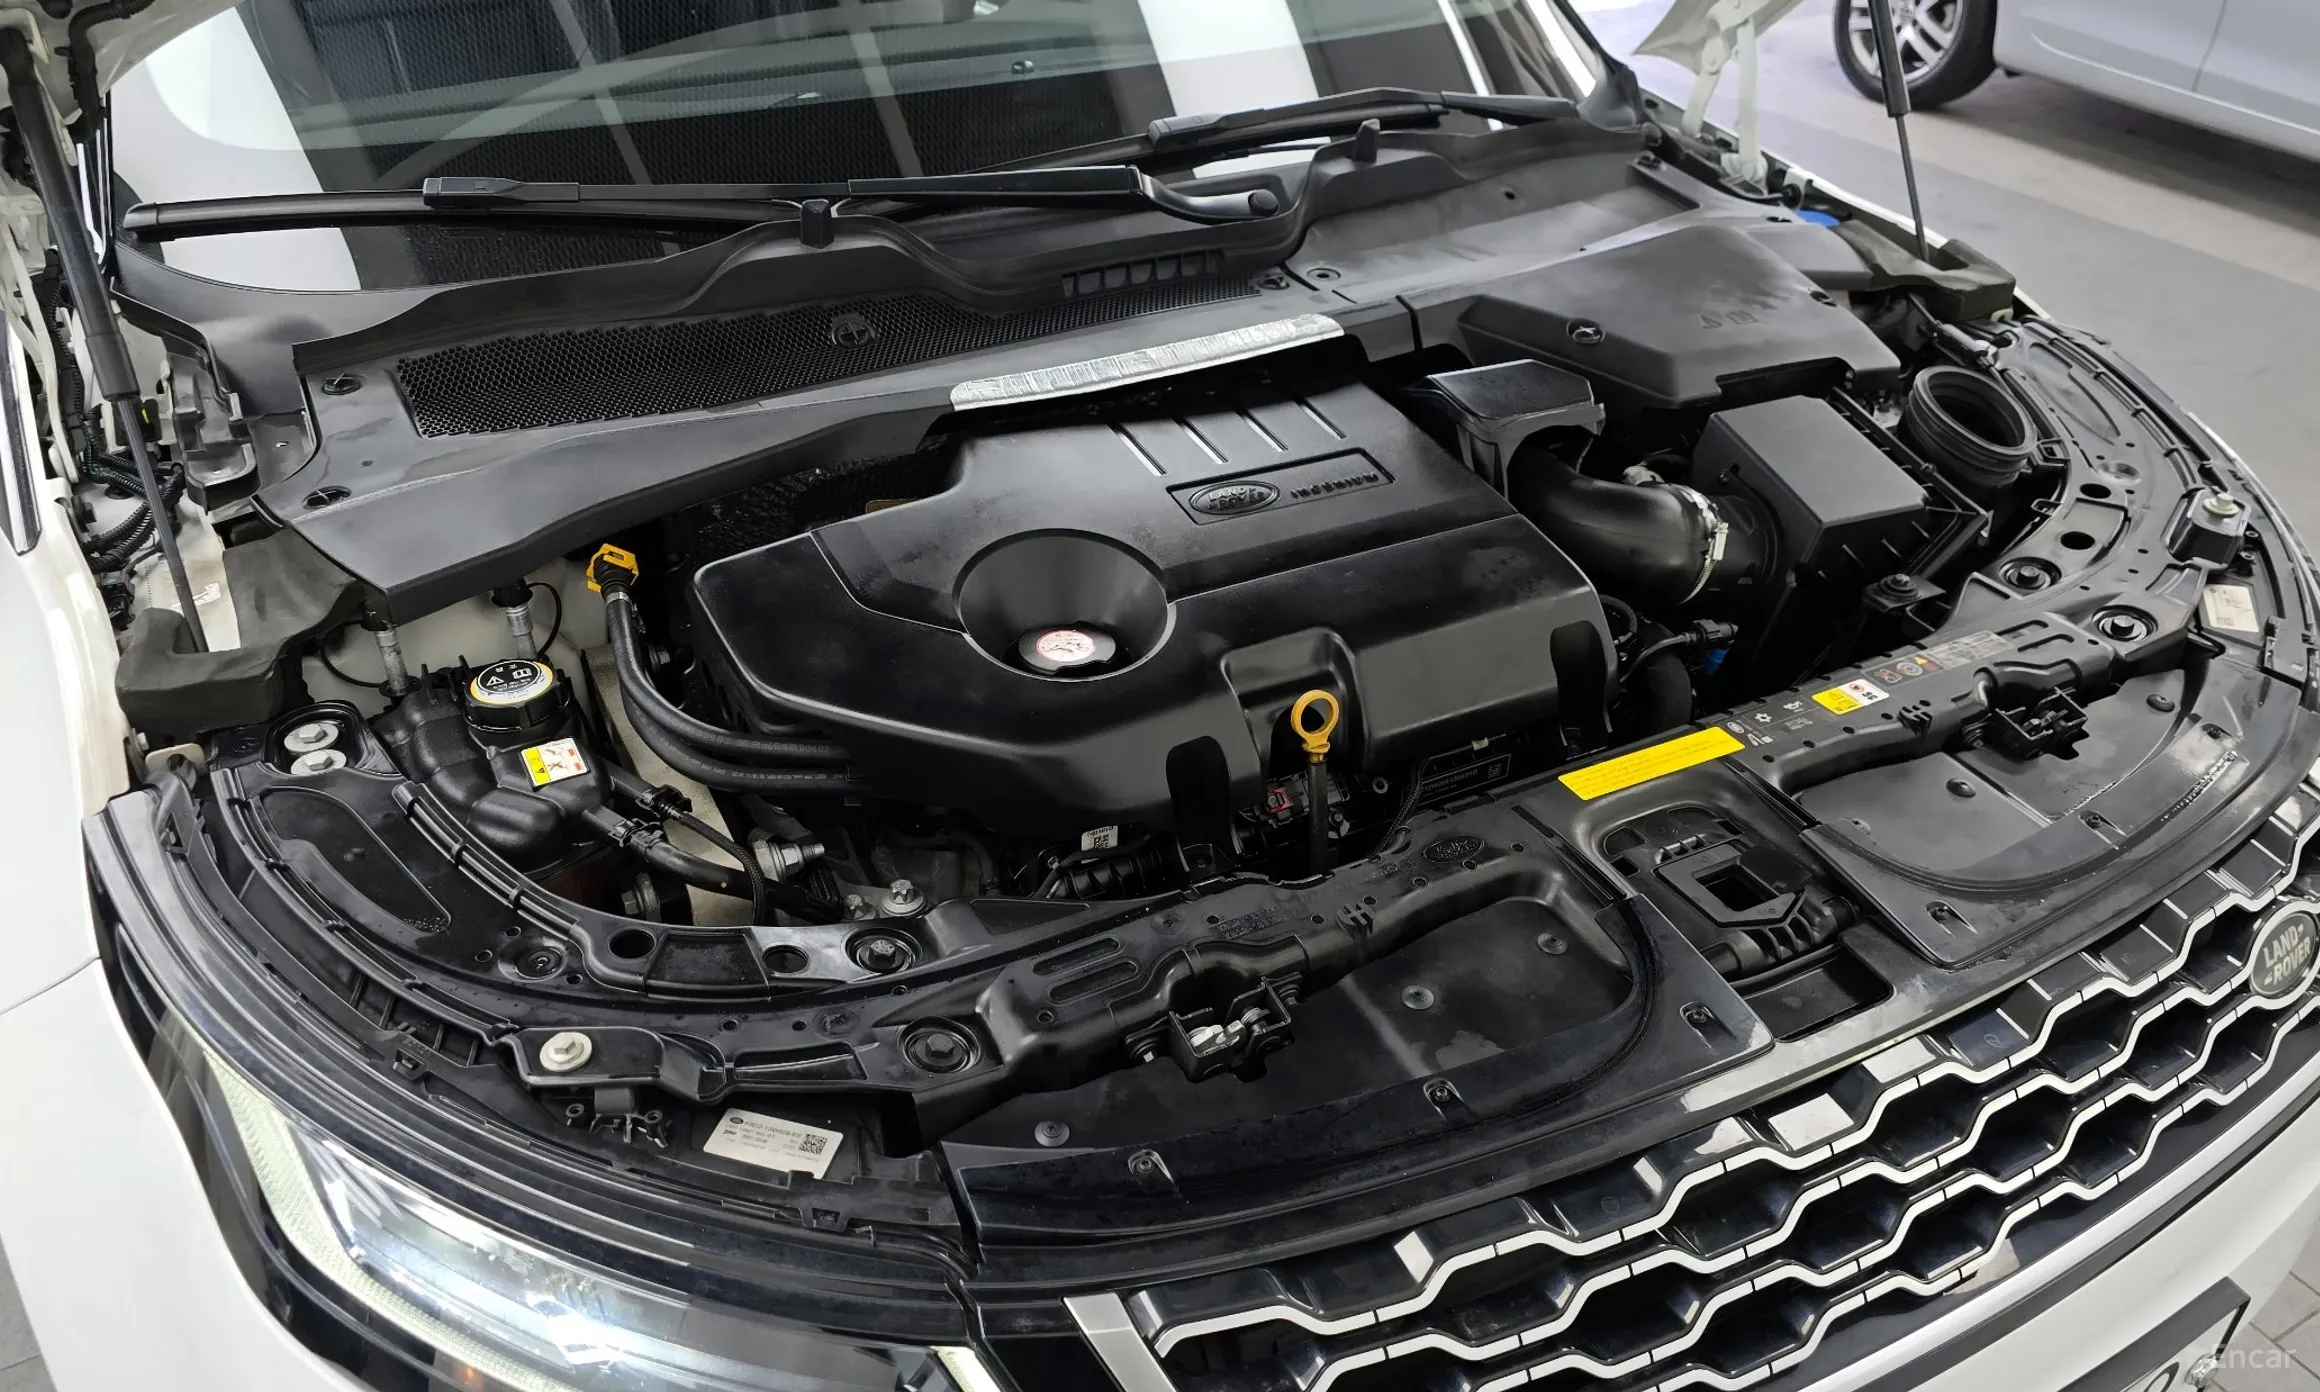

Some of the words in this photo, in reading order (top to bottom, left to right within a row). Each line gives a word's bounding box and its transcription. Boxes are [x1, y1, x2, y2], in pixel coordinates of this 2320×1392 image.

[1290, 472, 1380, 499] INGENIUM
[2262, 925, 2300, 969] LAND
[2272, 936, 2311, 986] ROVER
